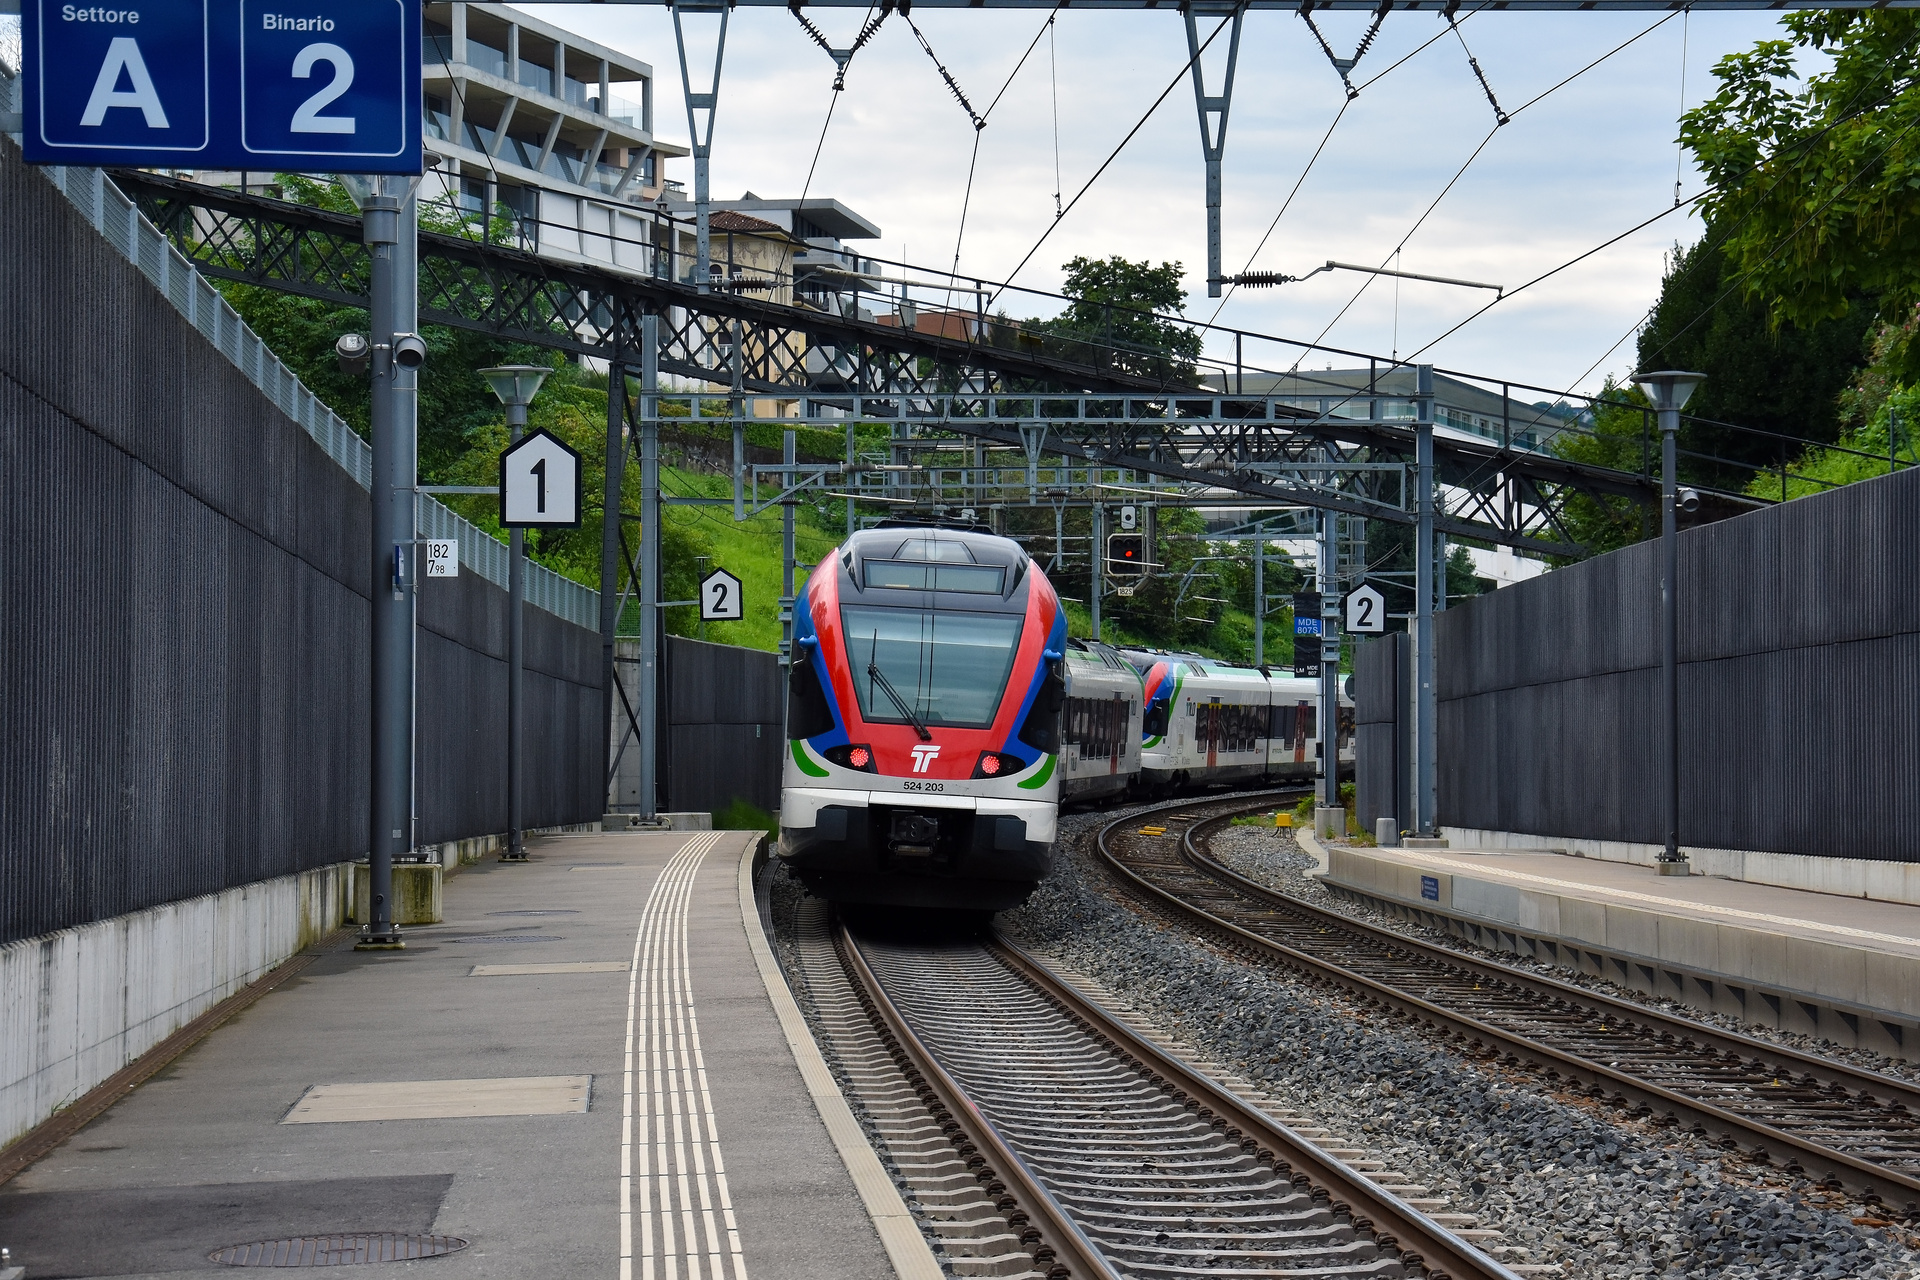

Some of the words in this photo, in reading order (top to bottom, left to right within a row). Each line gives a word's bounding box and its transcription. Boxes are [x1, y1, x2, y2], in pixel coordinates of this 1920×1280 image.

[62, 5, 139, 24] Settore
[263, 14, 335, 32] Binario
[79, 37, 170, 129] A
[290, 42, 356, 134] 2
[530, 458, 546, 514] 1
[428, 544, 448, 558] 182
[712, 583, 728, 613] 2
[1298, 618, 1317, 626] MDE
[1357, 597, 1373, 626] 2
[903, 782, 921, 791] 524
[925, 783, 944, 792] 203
